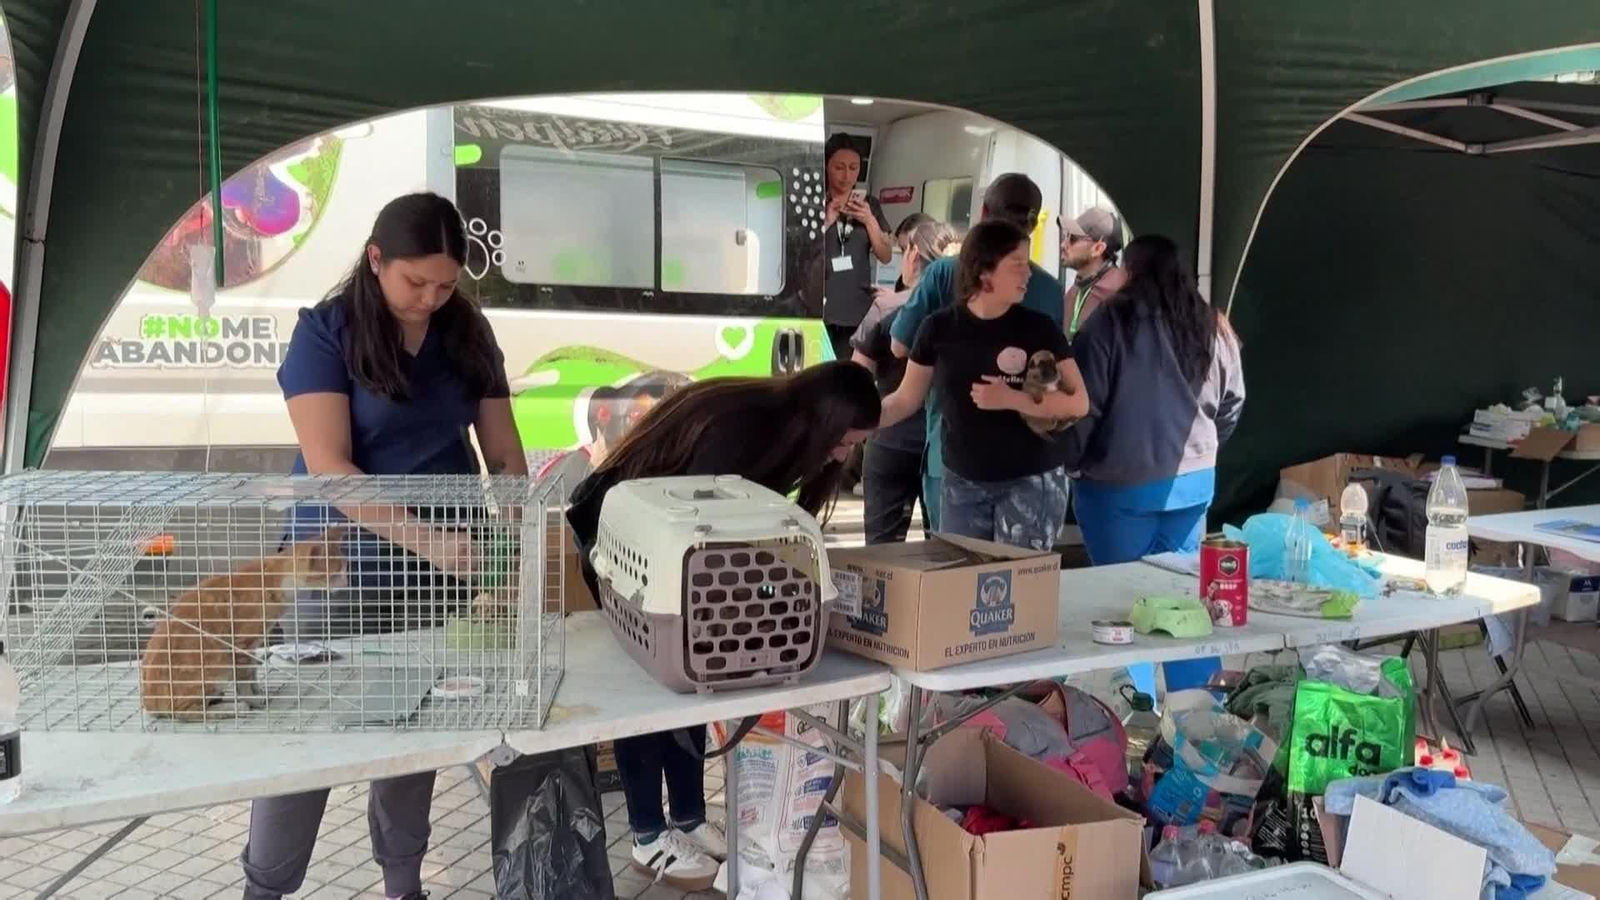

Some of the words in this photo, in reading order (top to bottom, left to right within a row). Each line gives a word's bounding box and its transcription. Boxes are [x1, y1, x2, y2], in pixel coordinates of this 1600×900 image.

[142, 316, 271, 339] #NOME
[970, 607, 1013, 628] QUAKER
[834, 630, 862, 646] EXPERTO
[863, 636, 872, 649] EN
[873, 641, 910, 659] NUTRICION
[944, 647, 953, 658] EL
[955, 640, 987, 656] EXPERTO
[988, 638, 998, 650] EN
[999, 632, 1036, 648] NUTRICION
[1305, 725, 1381, 765] alfa
[1061, 854, 1074, 900] cmpc
